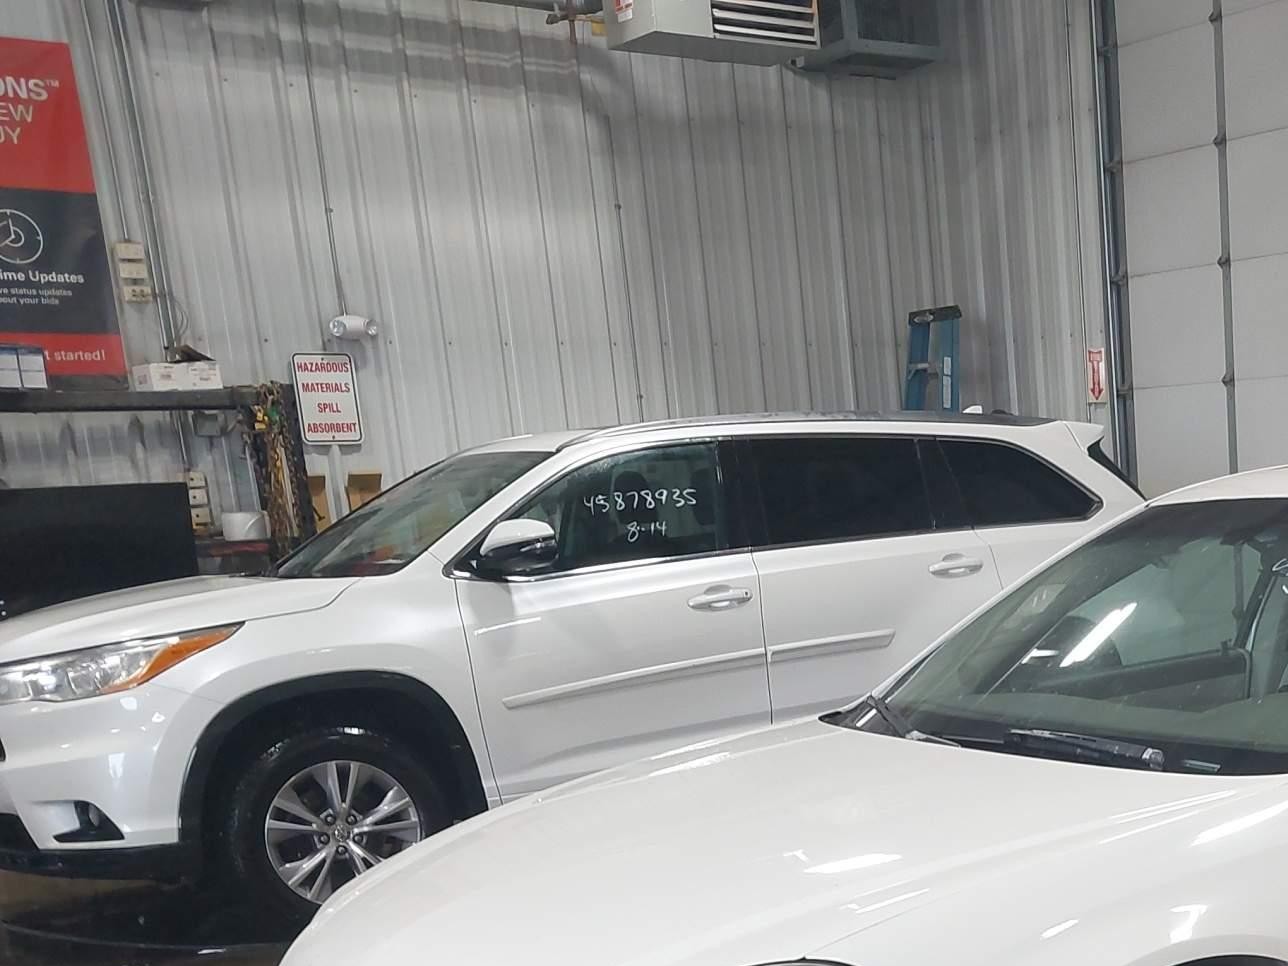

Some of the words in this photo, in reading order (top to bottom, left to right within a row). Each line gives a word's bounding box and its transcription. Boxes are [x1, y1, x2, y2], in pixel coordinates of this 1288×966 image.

[28, 270, 85, 284] Updates
[10, 287, 37, 295] status
[38, 288, 73, 297] updates
[19, 297, 39, 305] your
[54, 349, 106, 361] started!
[296, 362, 350, 373] HAZARDOUS
[302, 382, 351, 393] MATERIALS
[317, 402, 342, 413] SPILL
[307, 422, 357, 434] ABSORBENT
[583, 488, 697, 518] 45878935
